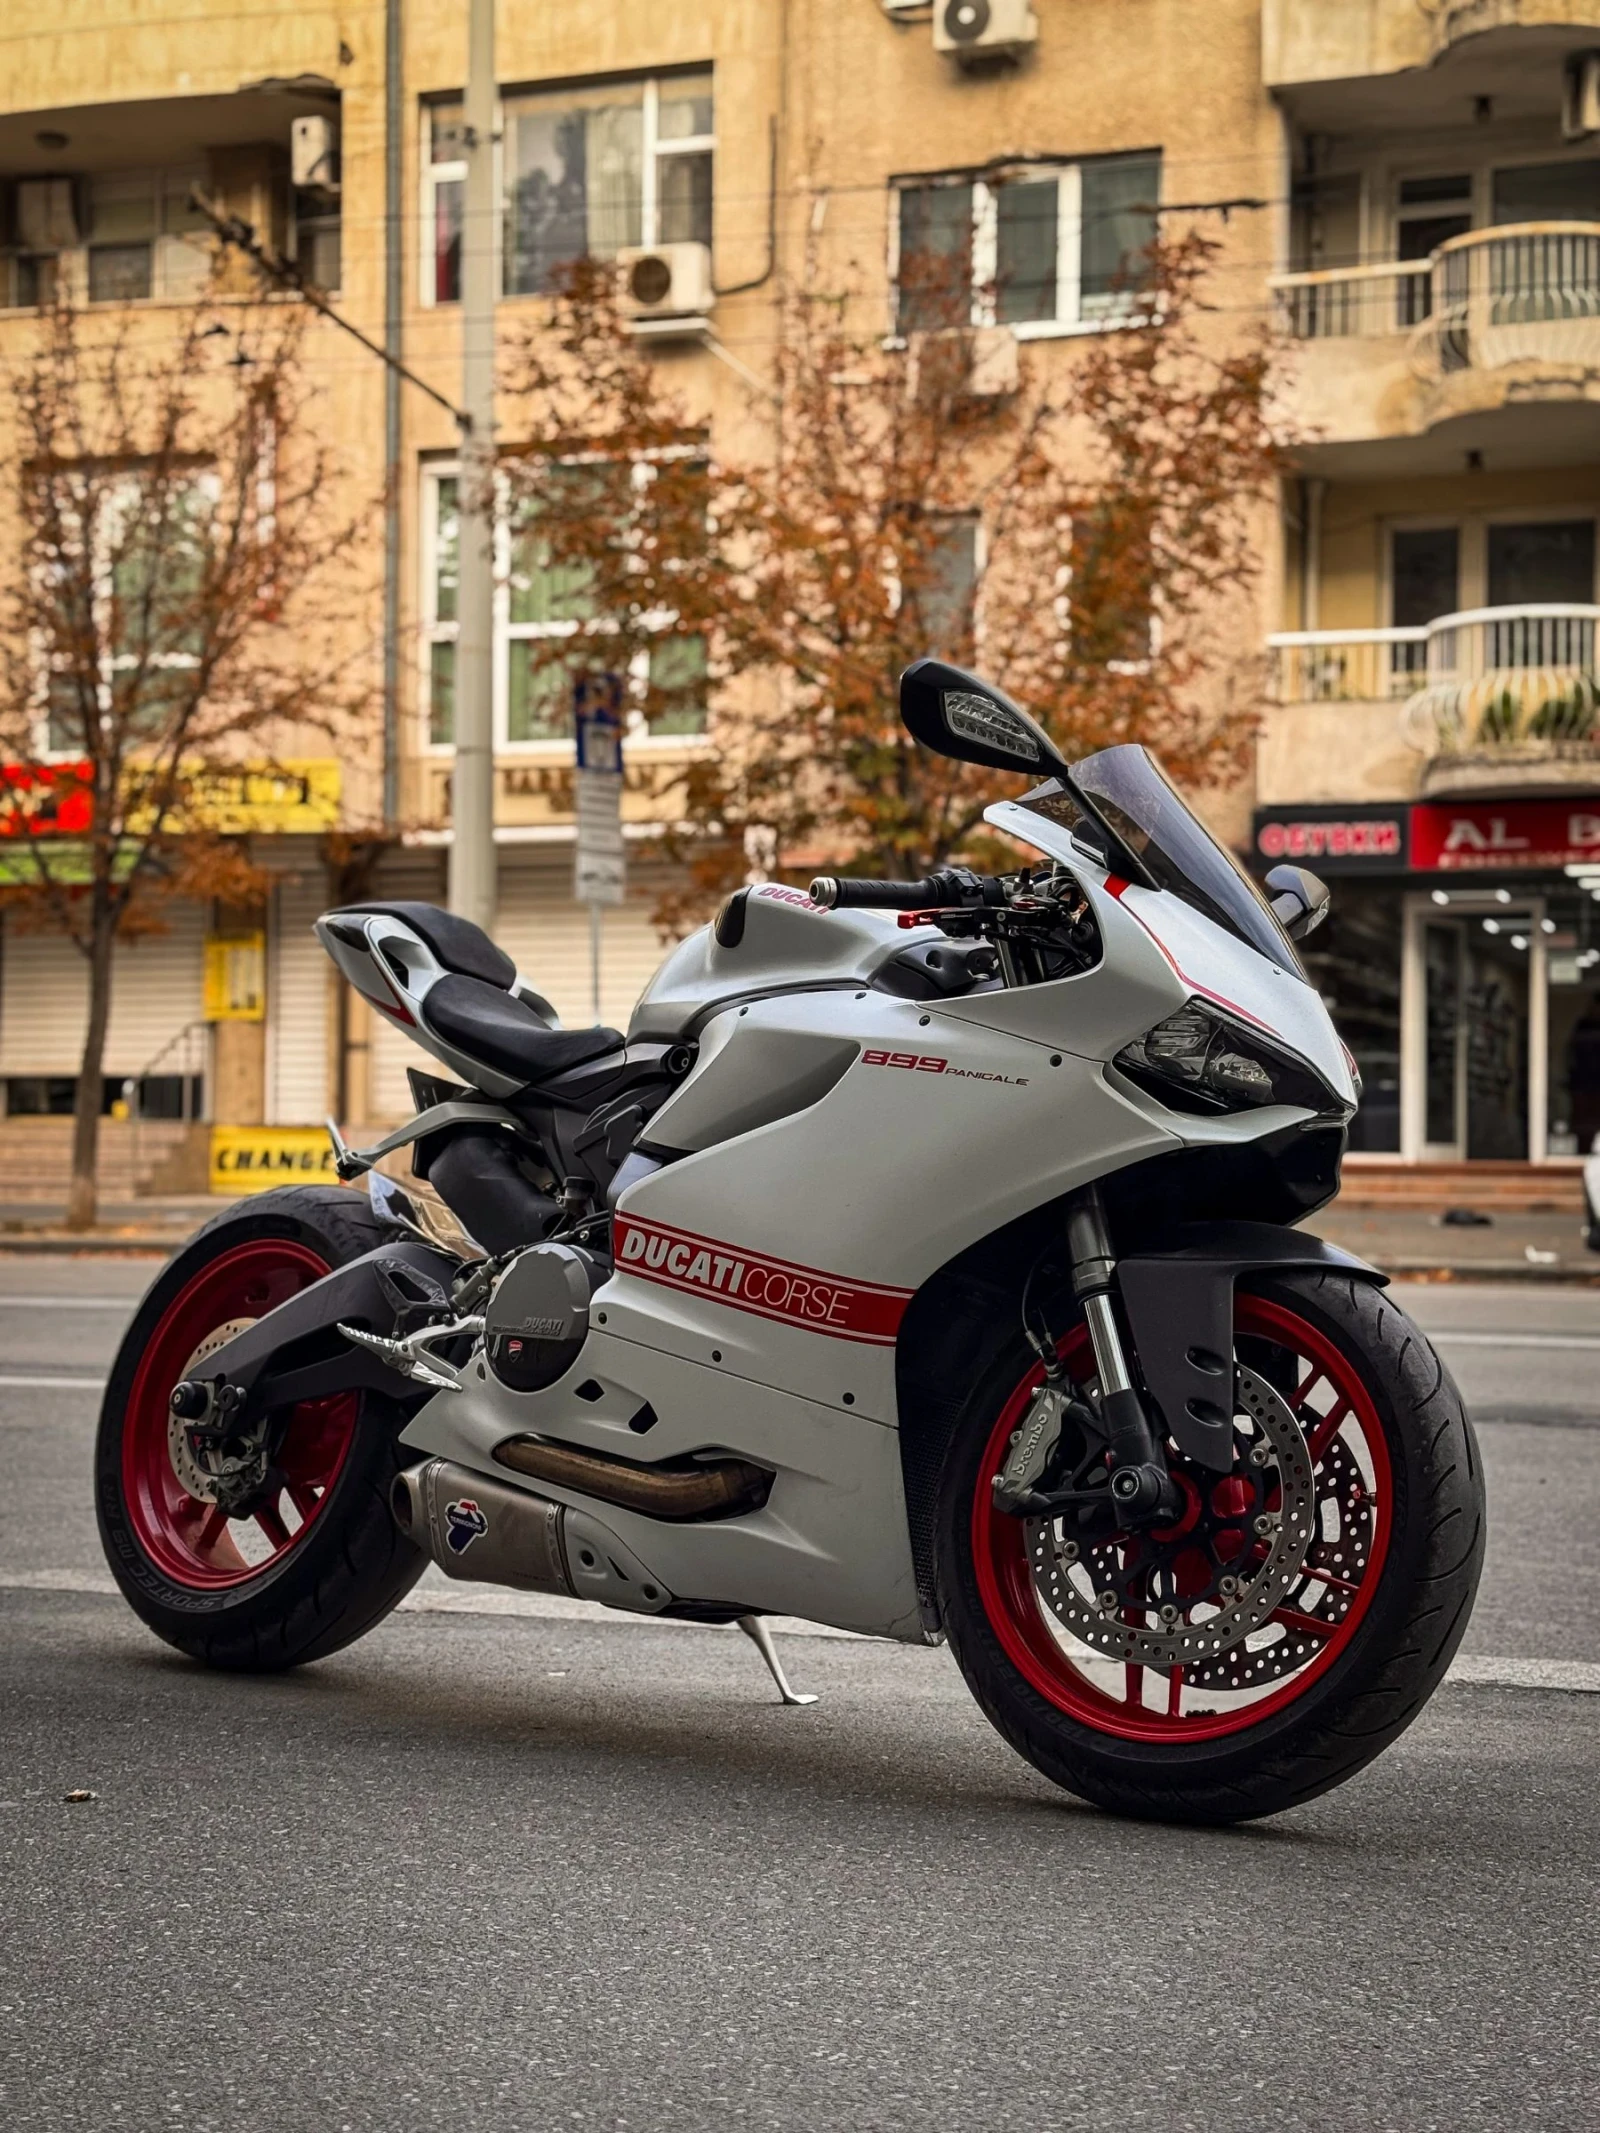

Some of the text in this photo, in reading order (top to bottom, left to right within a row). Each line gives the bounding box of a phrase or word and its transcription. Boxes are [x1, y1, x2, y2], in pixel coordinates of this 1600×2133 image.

[1258, 822, 1400, 857] ОБУВКИ
[1444, 818, 1530, 850] AL
[861, 1050, 1030, 1086] 899 PANIGALE
[217, 1150, 333, 1171] CHANGE
[621, 1229, 854, 1324] DUCATI CORSE
[525, 1316, 564, 1331] DUCATI
[1012, 1413, 1047, 1476] brembo
[129, 1567, 222, 1610] SPORTEC
